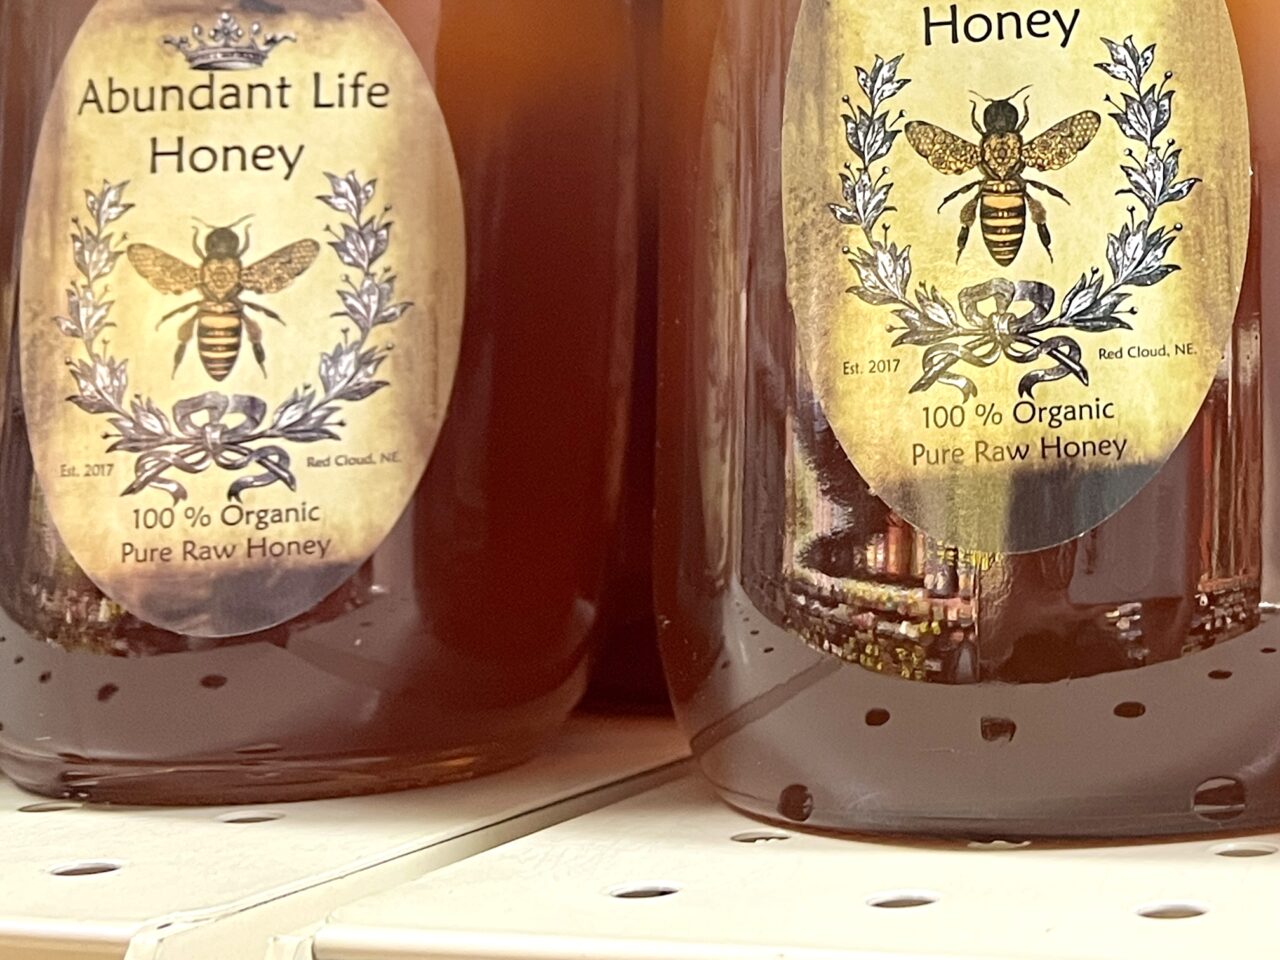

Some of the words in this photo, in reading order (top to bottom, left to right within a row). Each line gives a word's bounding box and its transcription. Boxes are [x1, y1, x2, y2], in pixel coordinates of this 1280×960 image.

[923, 6, 1080, 48] Honey
[76, 71, 292, 116] Abundant
[312, 71, 391, 110] Life
[149, 138, 305, 180] Honey
[842, 361, 864, 375] Est.
[868, 359, 901, 374] 2017
[1099, 347, 1123, 361] Red
[1126, 344, 1171, 360] Cloud,
[921, 405, 965, 429] 100
[974, 403, 1004, 425] %
[1013, 397, 1115, 428] Organic
[306, 456, 331, 468] Red
[912, 442, 965, 466] Pure
[974, 438, 1030, 462] Raw
[1040, 434, 1127, 464] Honey
[83, 462, 114, 478] 2017
[132, 508, 174, 529] 100
[184, 507, 212, 526] %
[221, 501, 320, 530] Organic
[121, 541, 172, 563] Pure
[182, 539, 236, 561] Raw
[246, 536, 331, 562] Honey
